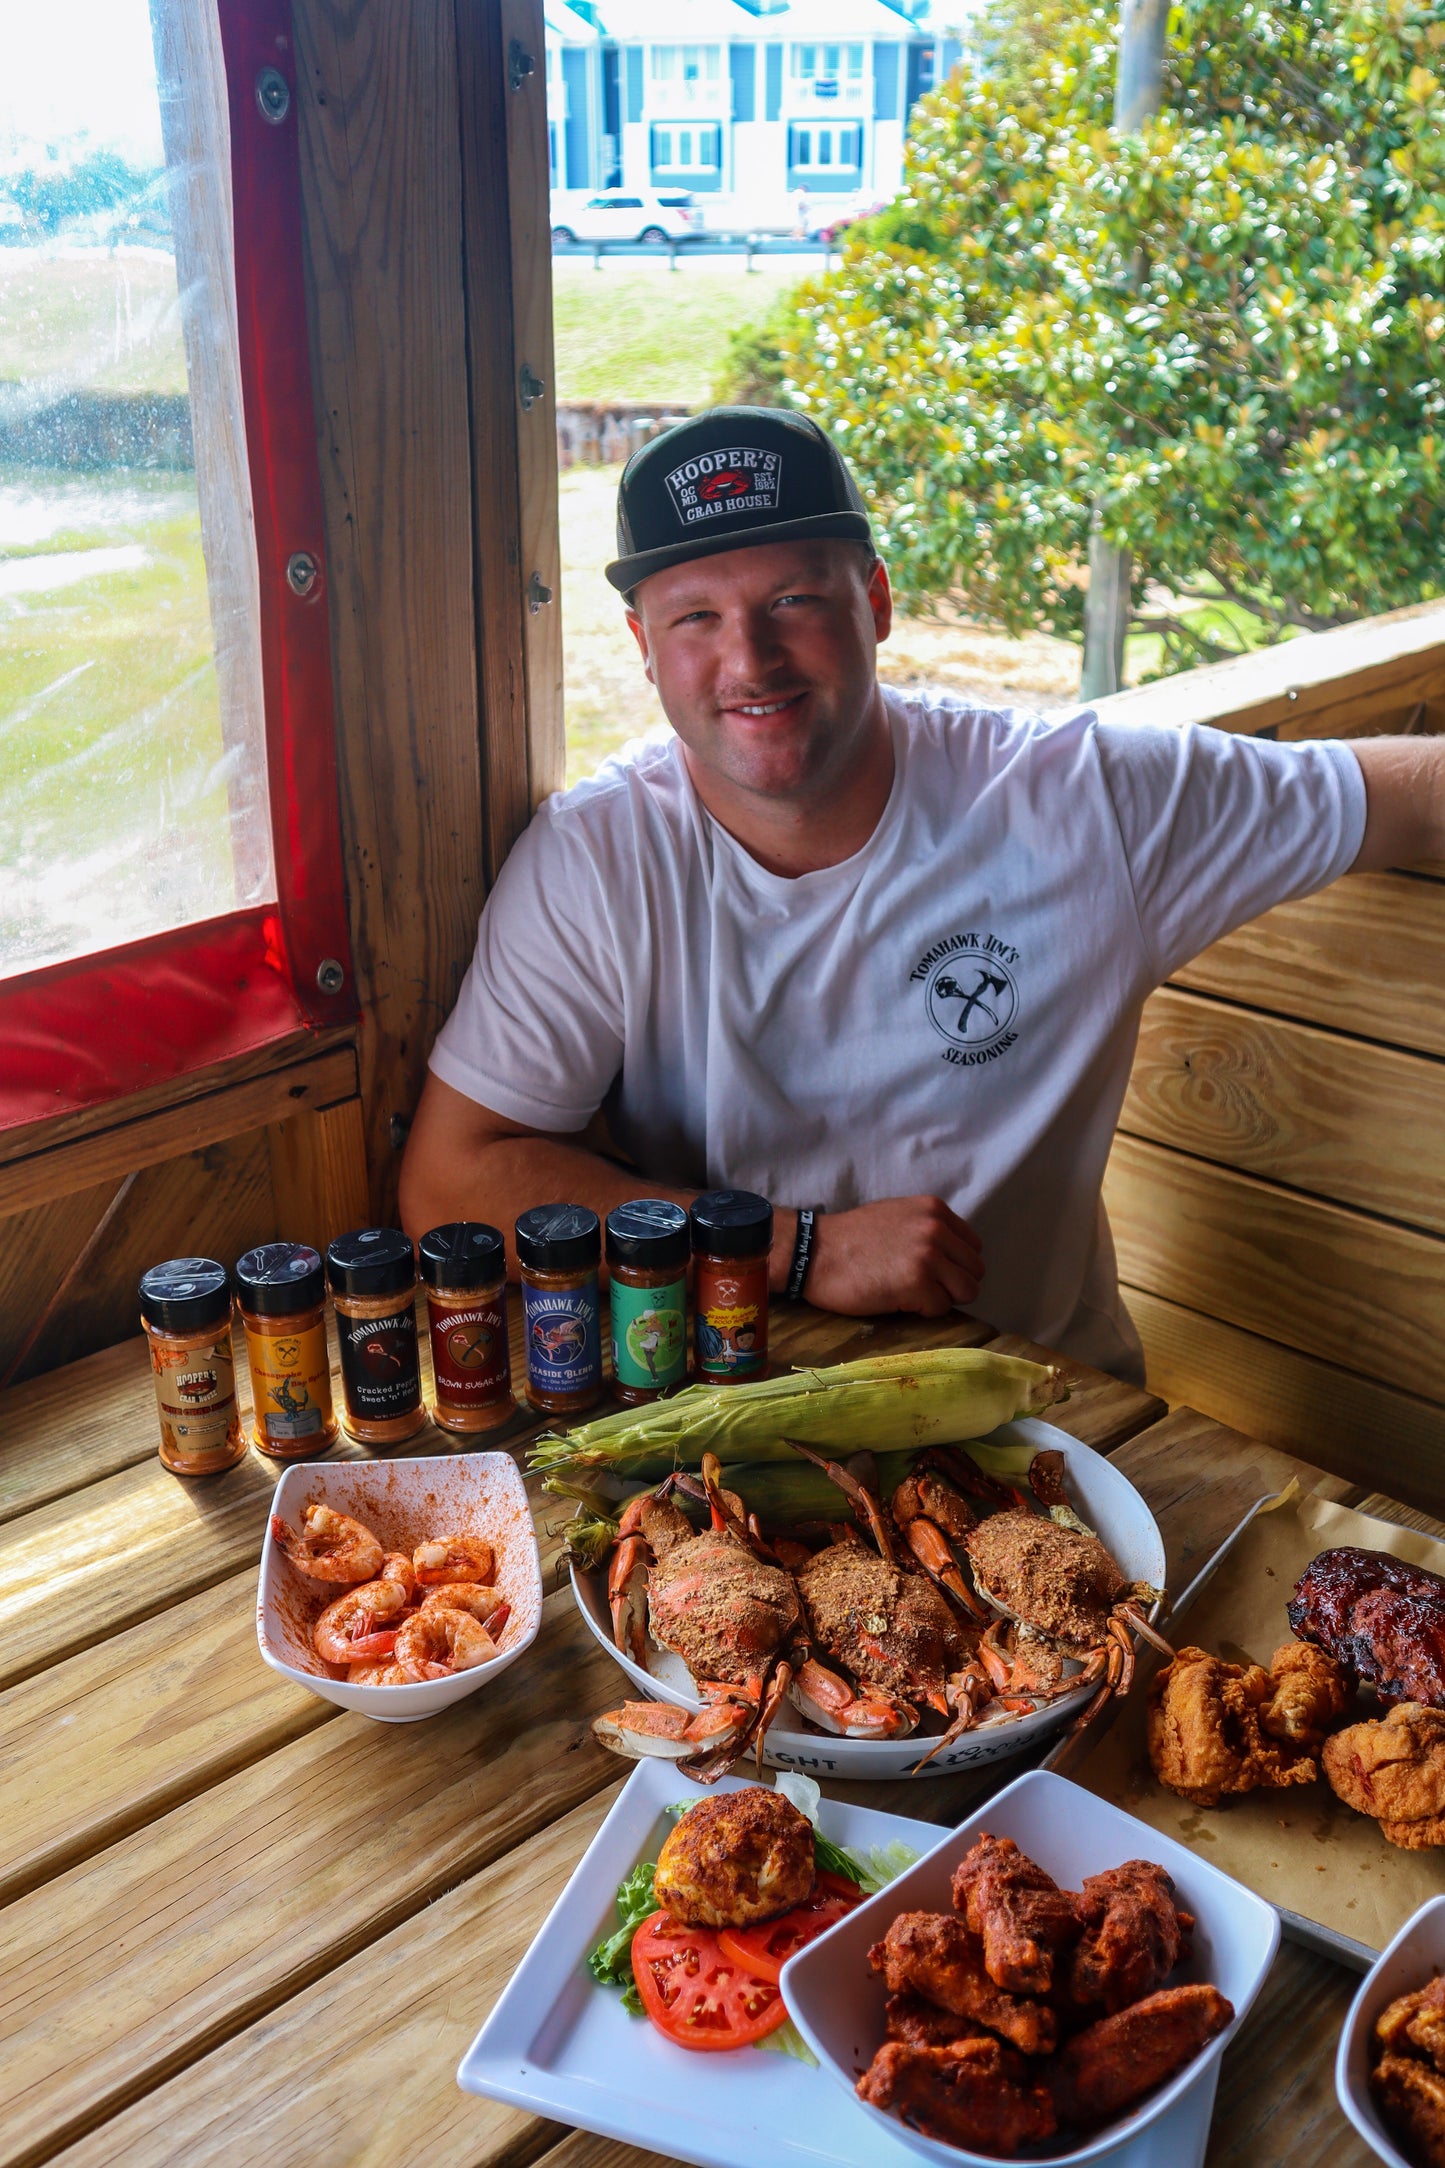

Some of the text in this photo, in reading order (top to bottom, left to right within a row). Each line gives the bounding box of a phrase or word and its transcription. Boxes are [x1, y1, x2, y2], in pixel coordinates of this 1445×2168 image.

[670, 450, 777, 490] HOOPER'S
[754, 472, 776, 482] EST.
[680, 486, 696, 498] OC
[754, 481, 776, 491] 1982
[682, 494, 698, 507] MD
[686, 494, 772, 521] CRAB HOUSE
[910, 933, 1020, 982] TOMAHAWK JIM'S
[942, 1032, 1020, 1066] SEASONING
[436, 1312, 484, 1333] TOMAHAWK
[348, 1318, 400, 1344] TOMAHAWK
[176, 1370, 217, 1386] HOOPER'S
[530, 1363, 593, 1379] SEASIDE BLEND
[356, 1385, 392, 1394] Cracked
[438, 1375, 462, 1389] BROWN
[464, 1378, 494, 1390] SUGAR
[361, 1395, 386, 1403] Sweet
